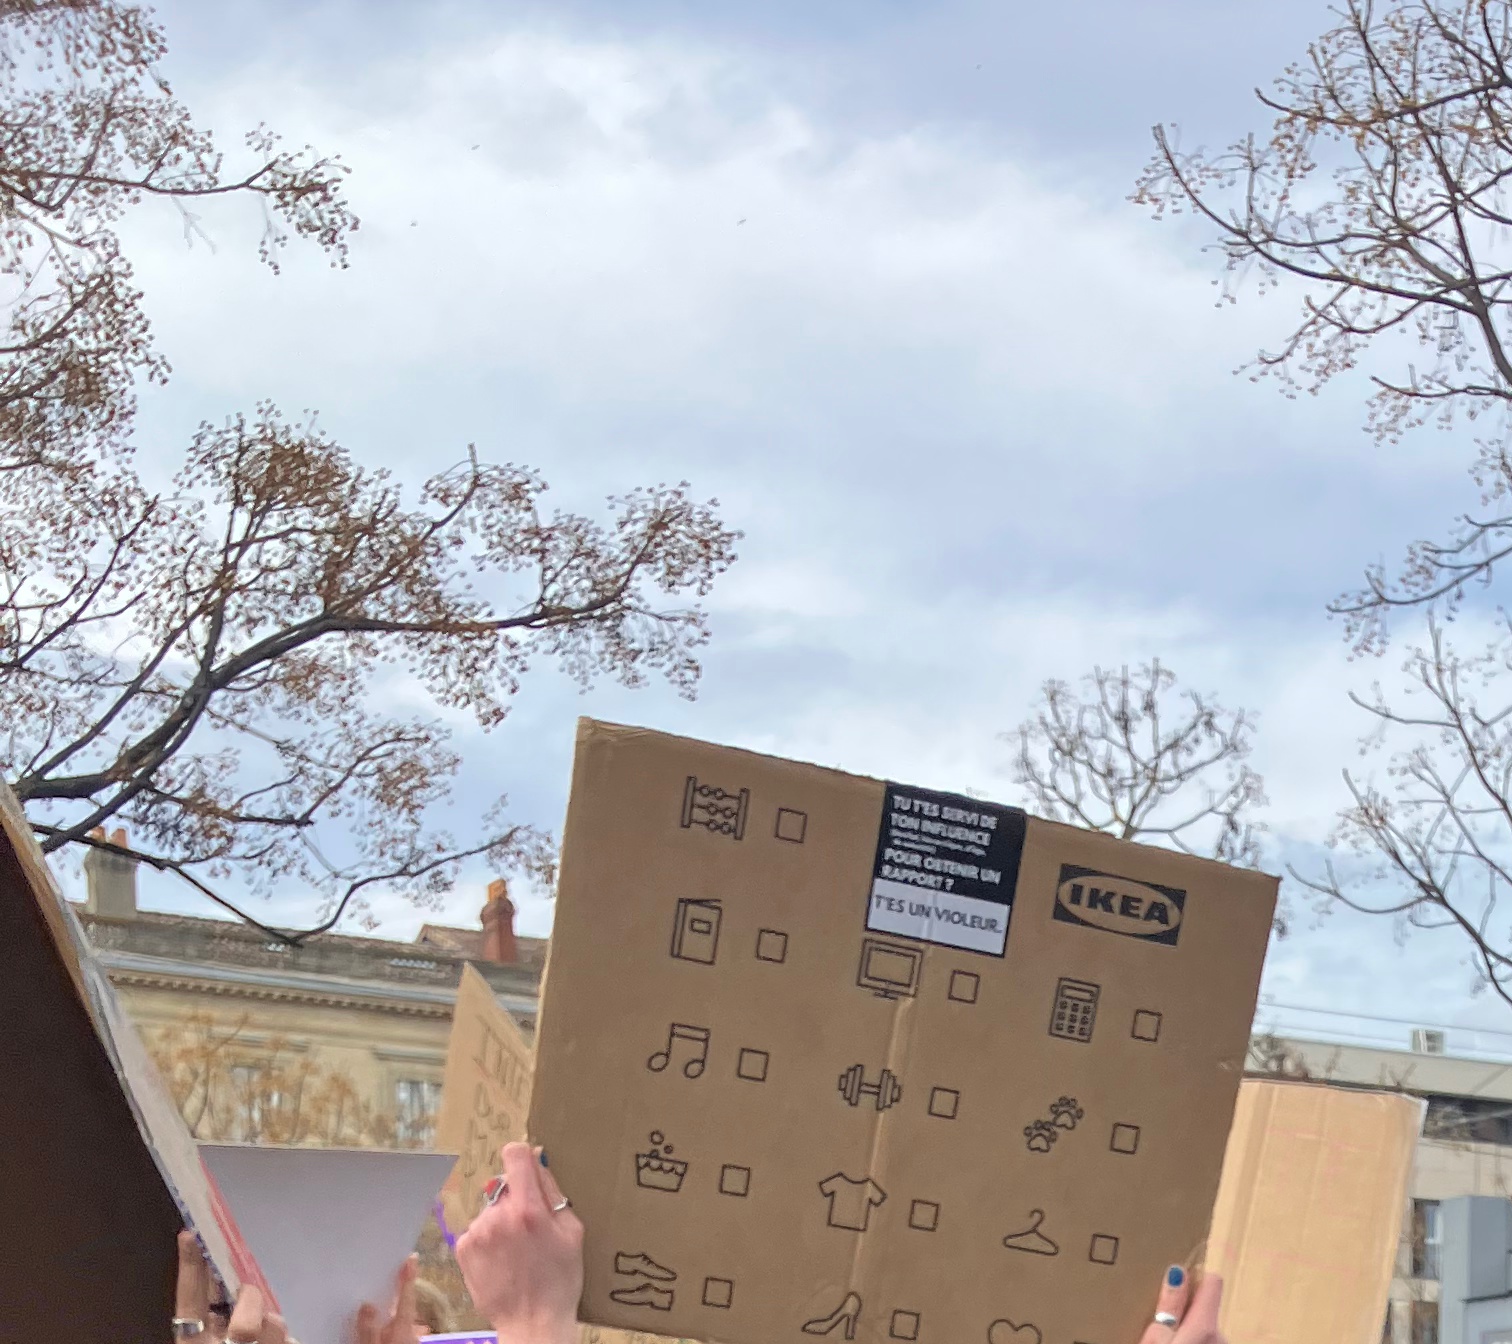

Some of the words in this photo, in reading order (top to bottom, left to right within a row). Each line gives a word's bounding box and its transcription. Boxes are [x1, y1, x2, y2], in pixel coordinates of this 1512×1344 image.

[875, 895, 905, 912] T'ES
[909, 902, 931, 918] UN
[1069, 884, 1169, 925] IKEA
